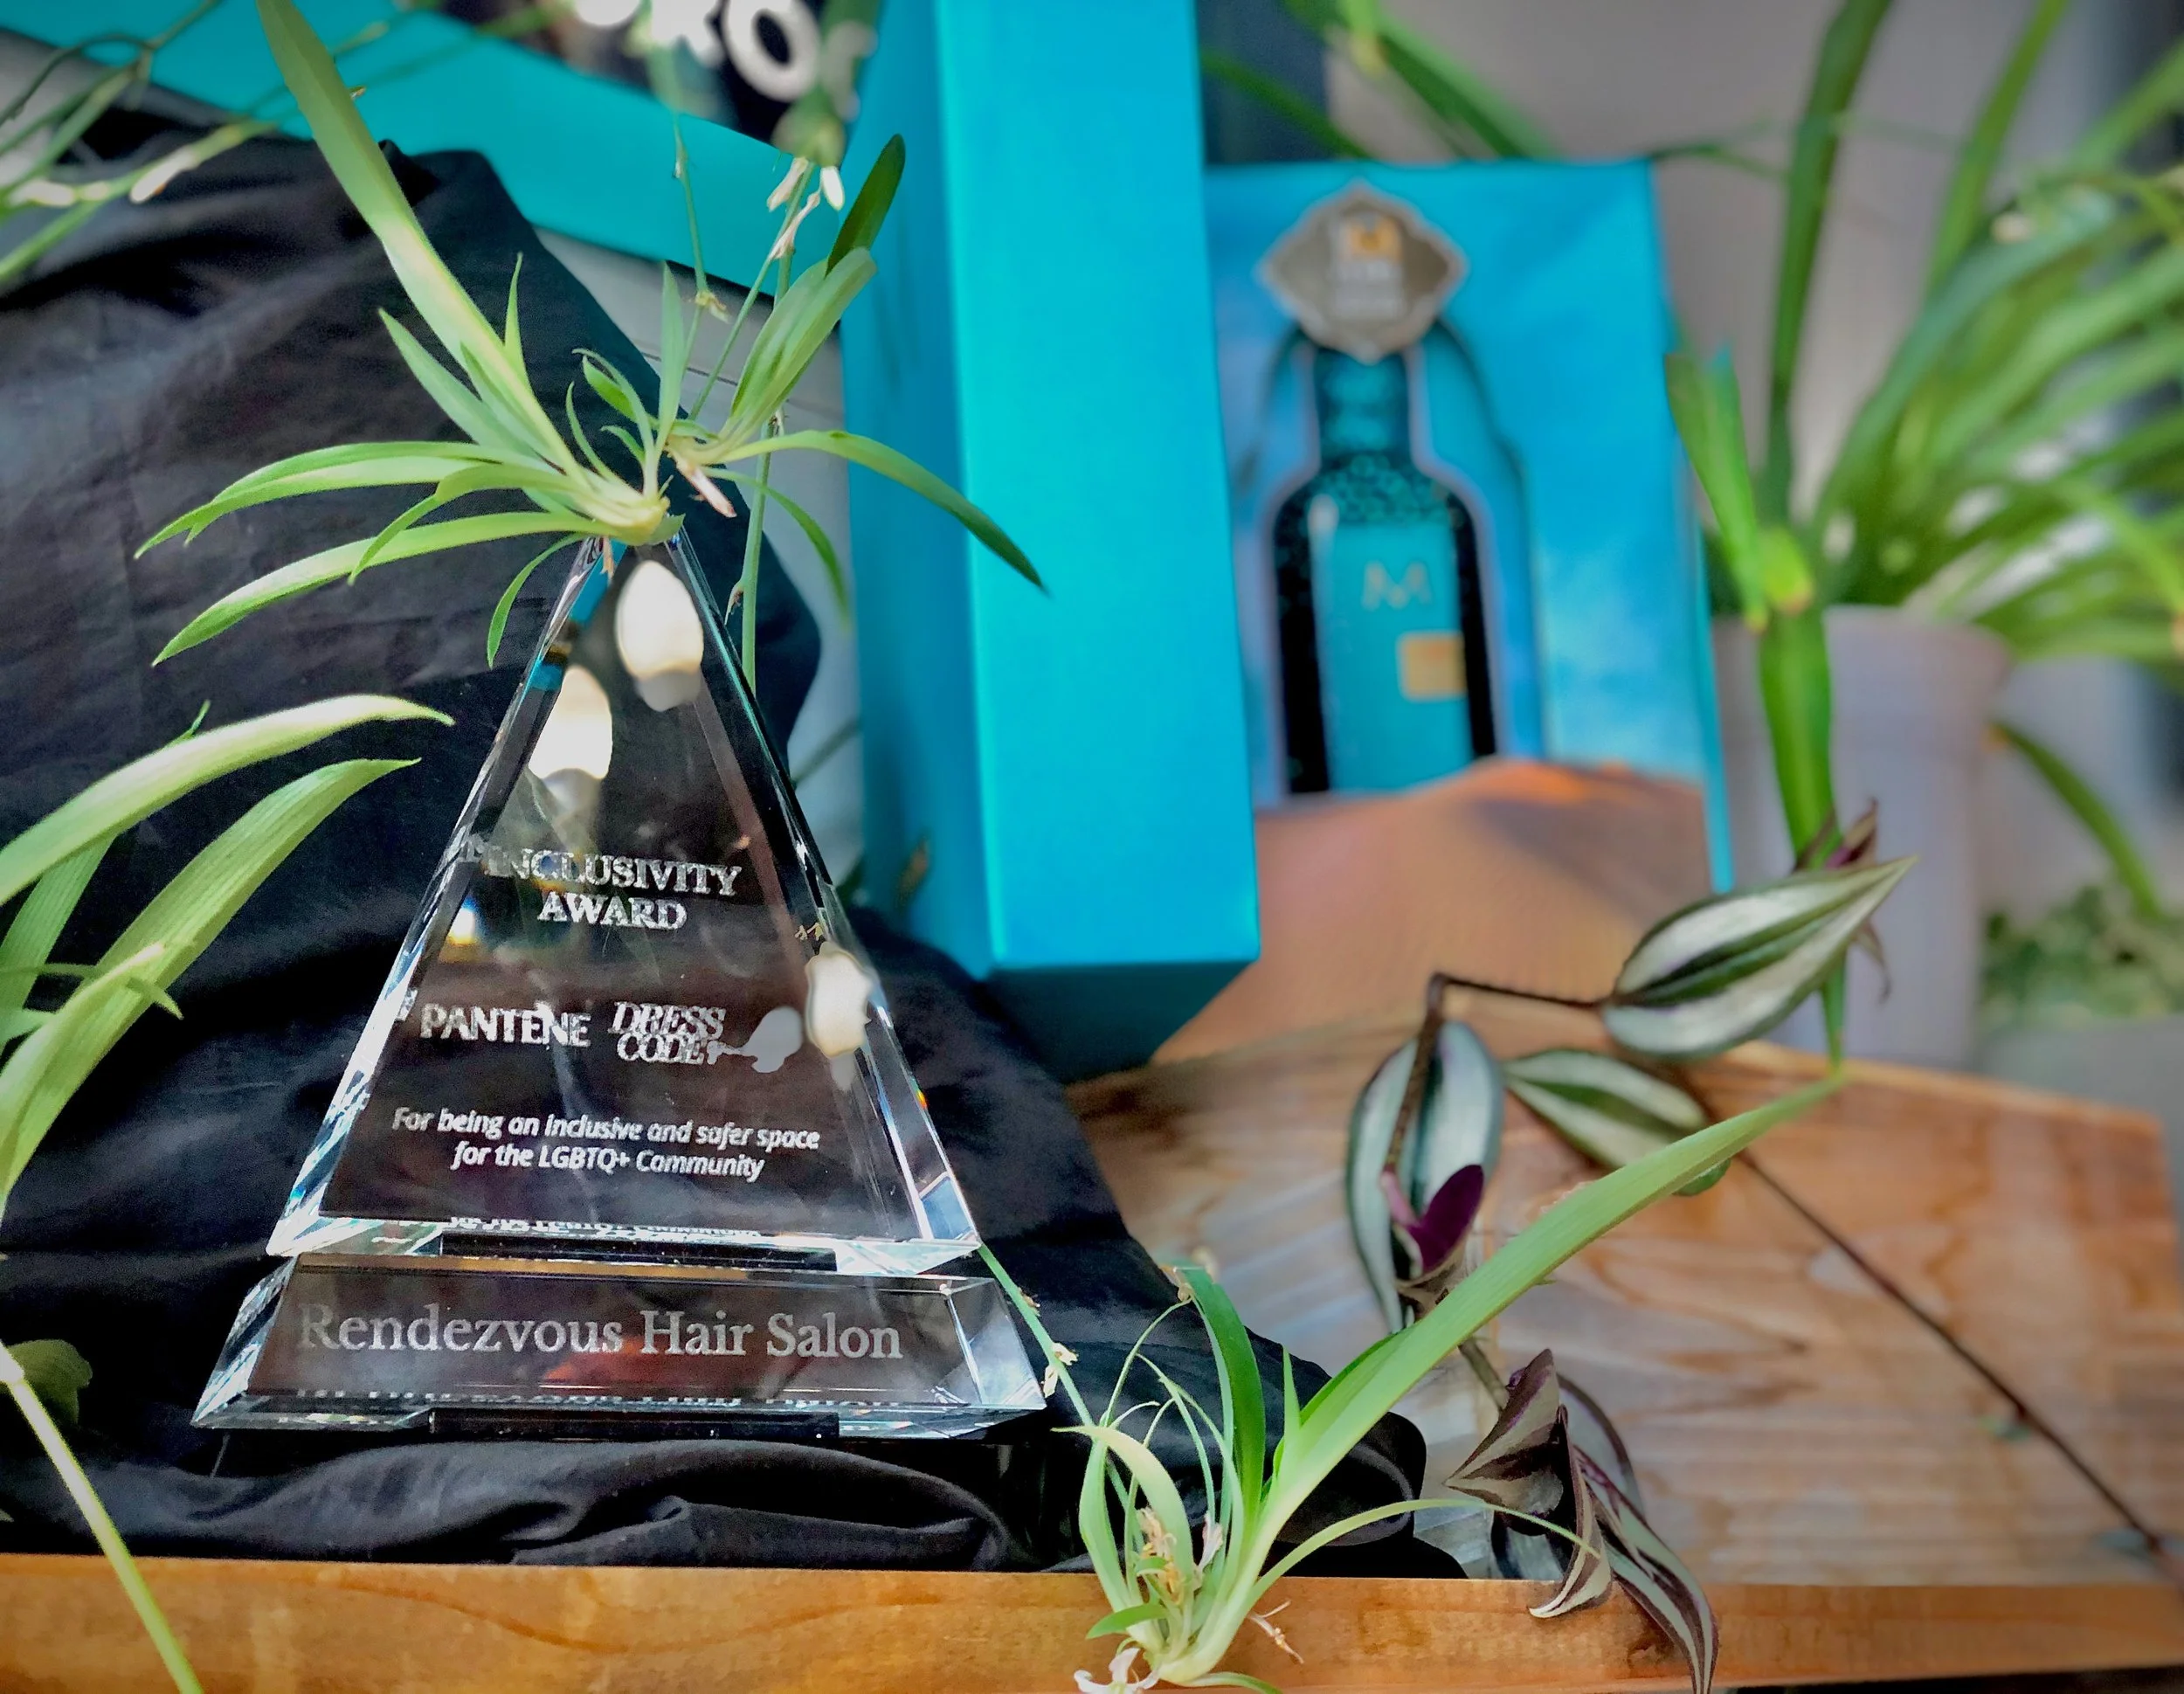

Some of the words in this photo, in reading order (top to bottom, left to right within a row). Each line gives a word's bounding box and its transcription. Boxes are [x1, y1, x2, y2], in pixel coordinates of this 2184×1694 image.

[537, 891, 688, 930] AWARD
[419, 1002, 591, 1048] PANTENE
[609, 1000, 727, 1035] DRESS
[392, 1107, 434, 1131] For
[437, 1108, 503, 1140] being
[508, 1117, 540, 1136] an
[544, 1113, 643, 1141] inclusive
[646, 1119, 695, 1144] and
[695, 1122, 754, 1151] safer
[757, 1127, 820, 1153] space
[450, 1140, 494, 1171] for
[494, 1144, 535, 1167] the
[538, 1145, 631, 1174] LGBTQ+
[636, 1150, 766, 1183] Community
[297, 1302, 623, 1353] Rendezvous
[639, 1310, 754, 1355] Hair
[766, 1312, 904, 1359] Salon
